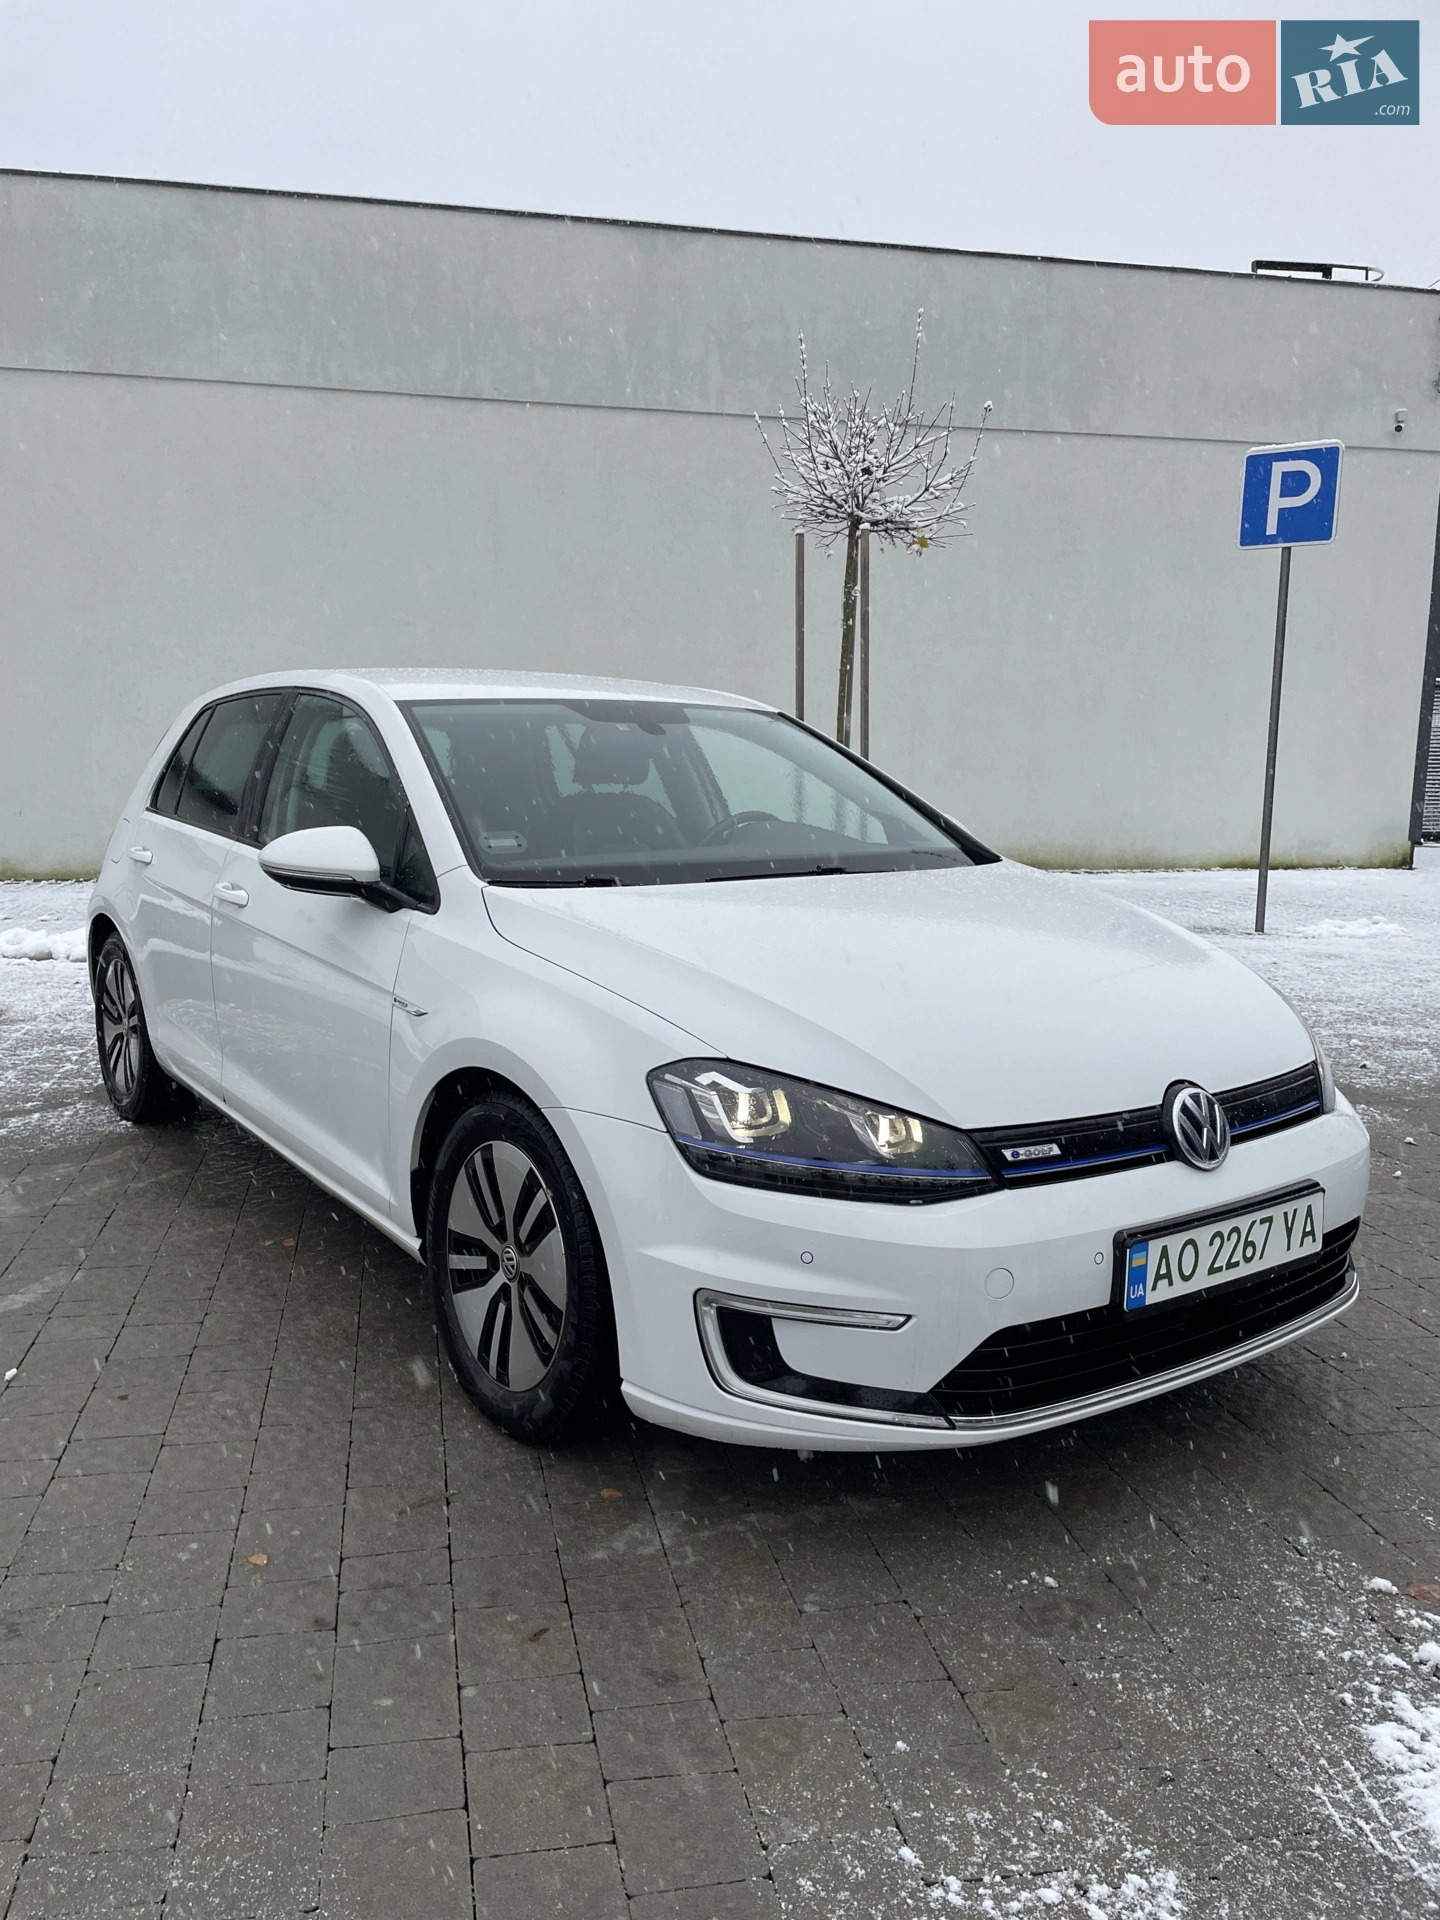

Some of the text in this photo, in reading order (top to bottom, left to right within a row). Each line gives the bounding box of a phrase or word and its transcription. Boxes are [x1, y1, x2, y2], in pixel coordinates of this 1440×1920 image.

[1265, 459, 1322, 536] P
[1151, 1203, 1317, 1292] AO 2267 YA
[1130, 1284, 1145, 1300] UA
